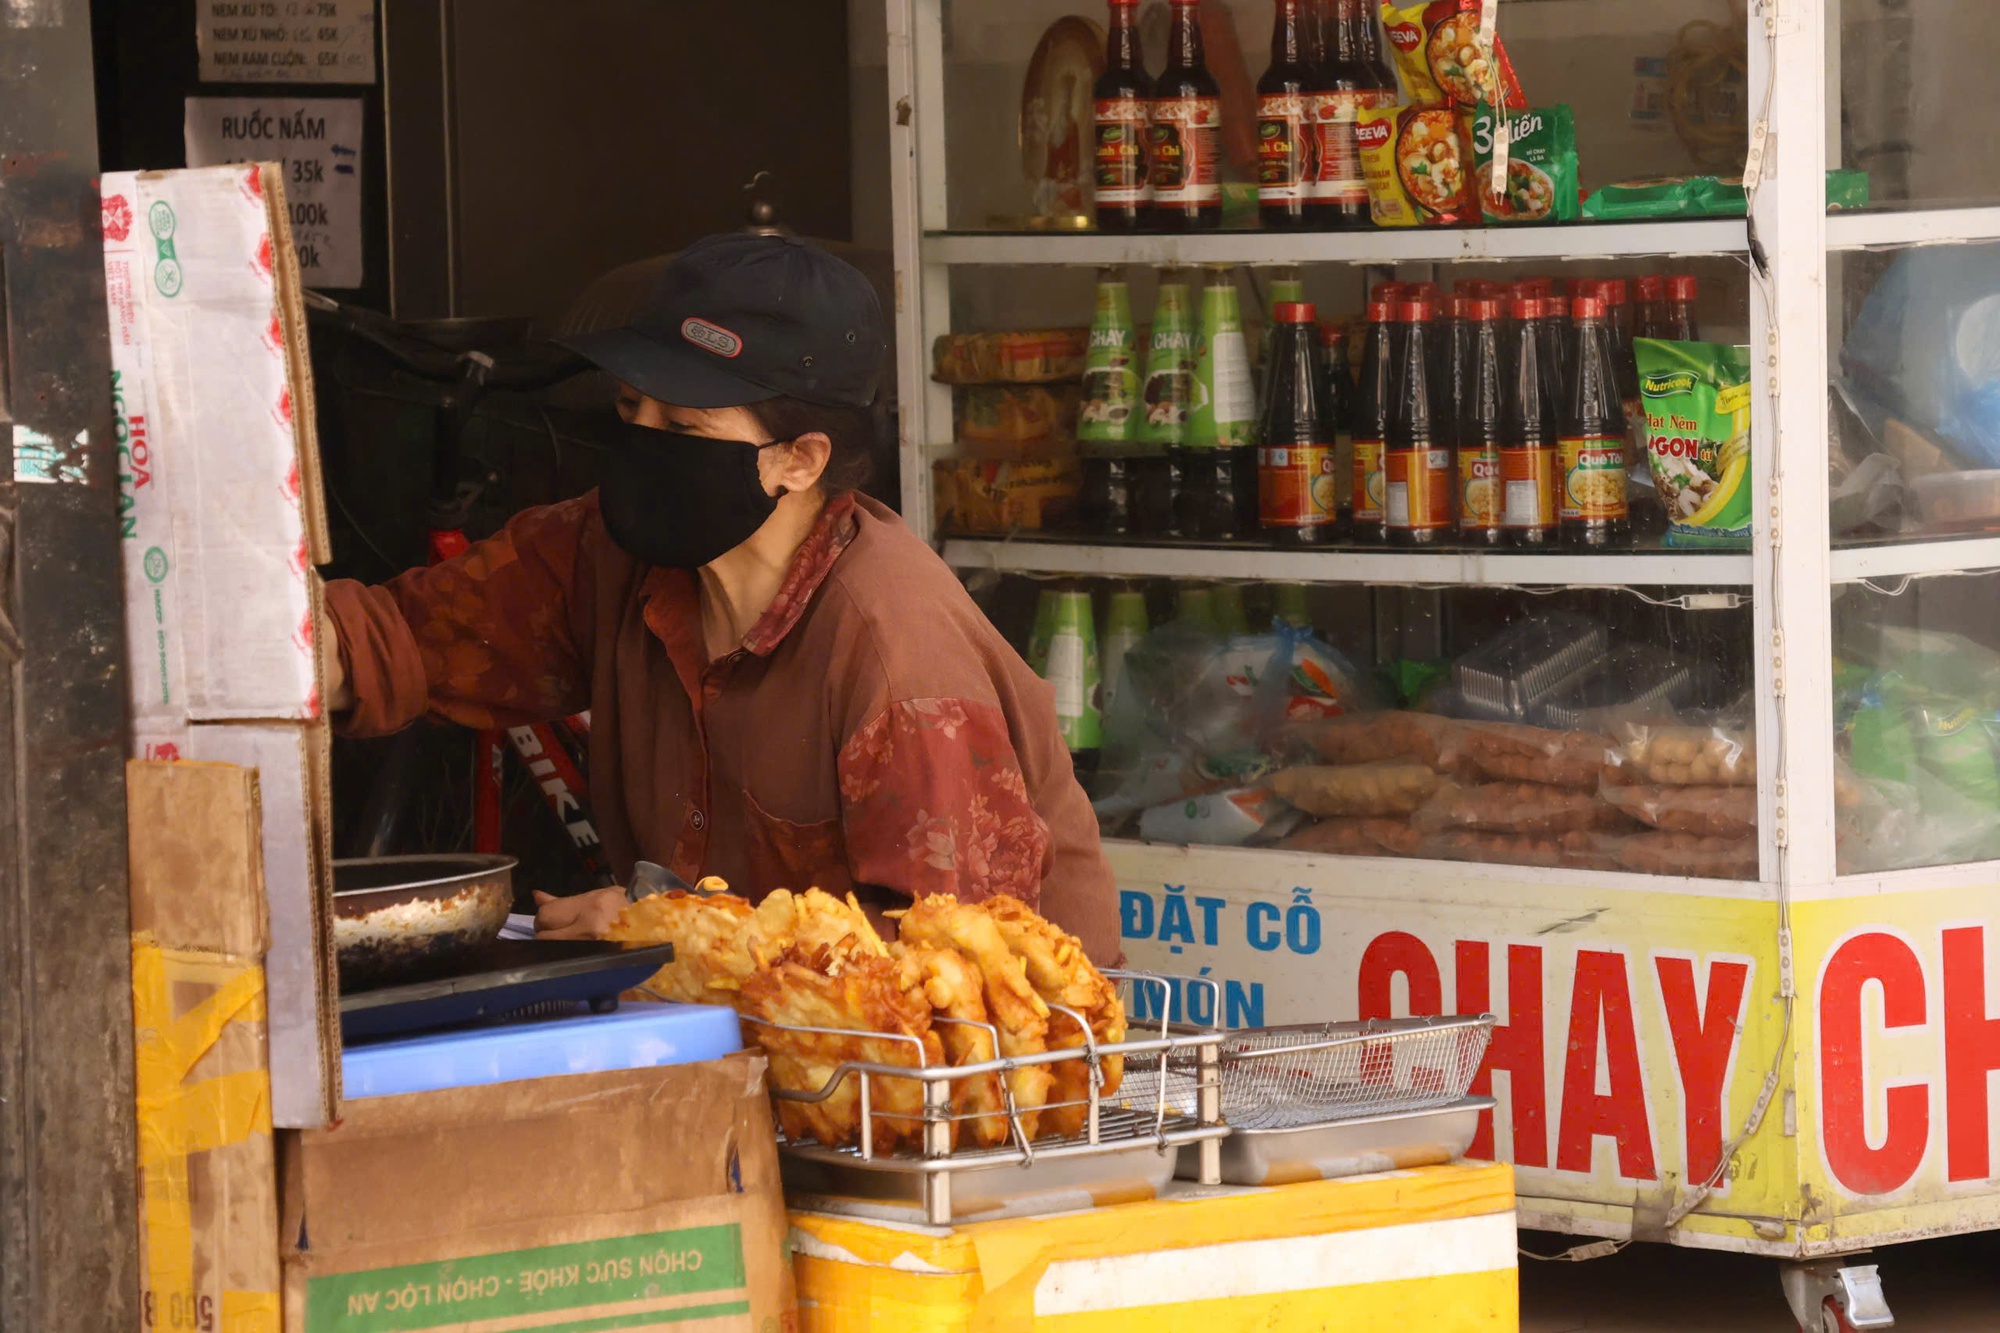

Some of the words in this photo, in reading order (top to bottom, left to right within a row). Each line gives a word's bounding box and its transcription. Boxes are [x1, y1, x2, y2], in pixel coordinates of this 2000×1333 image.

[222, 109, 274, 139] RUỐC
[279, 109, 325, 139] NẤM
[292, 158, 323, 183] 35k
[1090, 329, 1126, 347] CHAY
[1154, 331, 1192, 350] CHAY
[1644, 378, 1694, 393] Nutricook
[1669, 413, 1698, 432] Nêm
[127, 415, 152, 490] HOA
[1579, 453, 1607, 470] Quê
[508, 725, 600, 848] BIKE
[1119, 884, 1226, 954] ĐẶT
[1246, 886, 1321, 955] CỖ
[1133, 966, 1264, 1028] MÓN
[1358, 931, 1754, 1188] CHAY
[586, 1256, 633, 1287] SỨC
[639, 1248, 703, 1279] CHỌN
[438, 1275, 500, 1305] CHỌN
[519, 1264, 580, 1297] KHỎE
[347, 1290, 382, 1316] AN
[385, 1281, 432, 1312] LỘC
